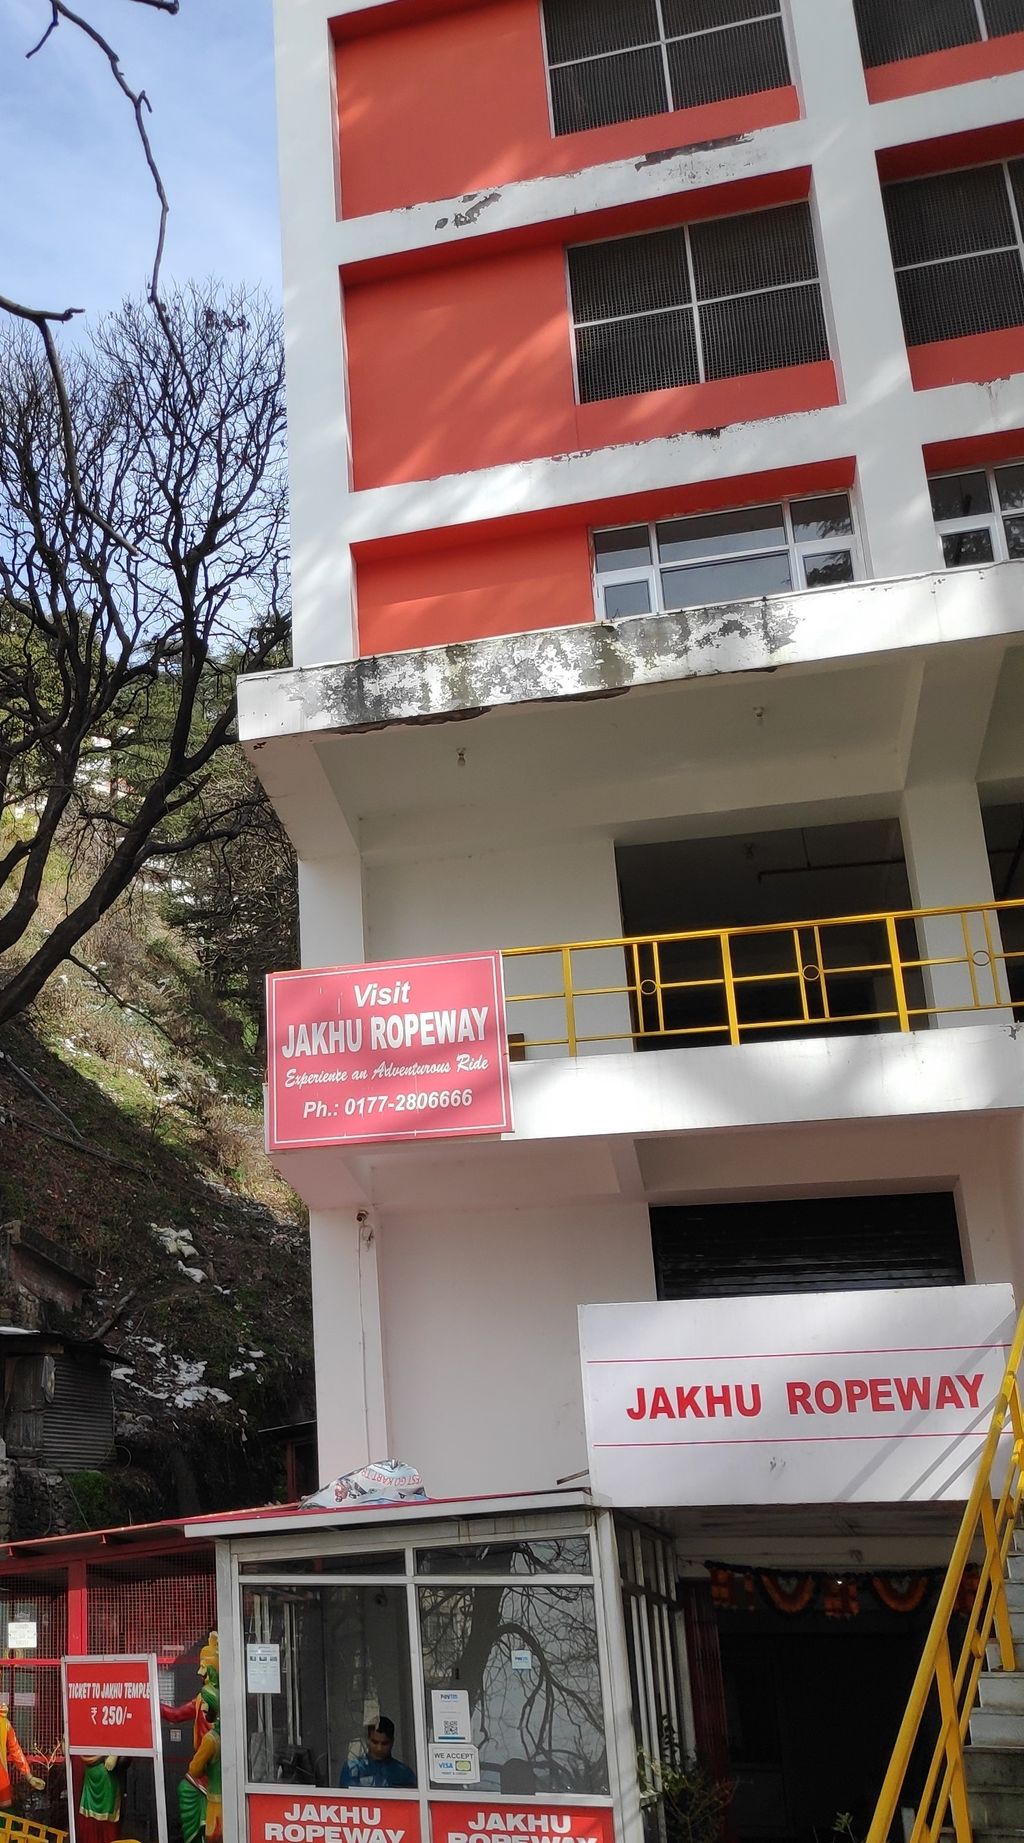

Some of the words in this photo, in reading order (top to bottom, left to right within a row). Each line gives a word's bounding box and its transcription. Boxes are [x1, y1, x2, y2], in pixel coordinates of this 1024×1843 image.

[353, 980, 411, 1008] Visit
[281, 1018, 363, 1058] JAKHU
[370, 1006, 489, 1050] ROPEWAY
[285, 1068, 349, 1089] Experience
[351, 1069, 368, 1080] an
[371, 1061, 452, 1080] Adventurous
[456, 1053, 488, 1073] Ride
[344, 1088, 473, 1116] 0177-2806666
[626, 1383, 762, 1421] JAKHU
[786, 1373, 985, 1417] ROPEWAY
[68, 1682, 91, 1700] TICKET
[91, 1682, 101, 1700] TO
[101, 1682, 123, 1700] JAKHU
[124, 1682, 150, 1700] TEMPLE
[101, 1705, 133, 1726] 250/-
[284, 1803, 381, 1825] JAKHU
[468, 1812, 571, 1834] JAKHU
[264, 1822, 406, 1843] ROPEWAY
[447, 1832, 598, 1843] ROPE
